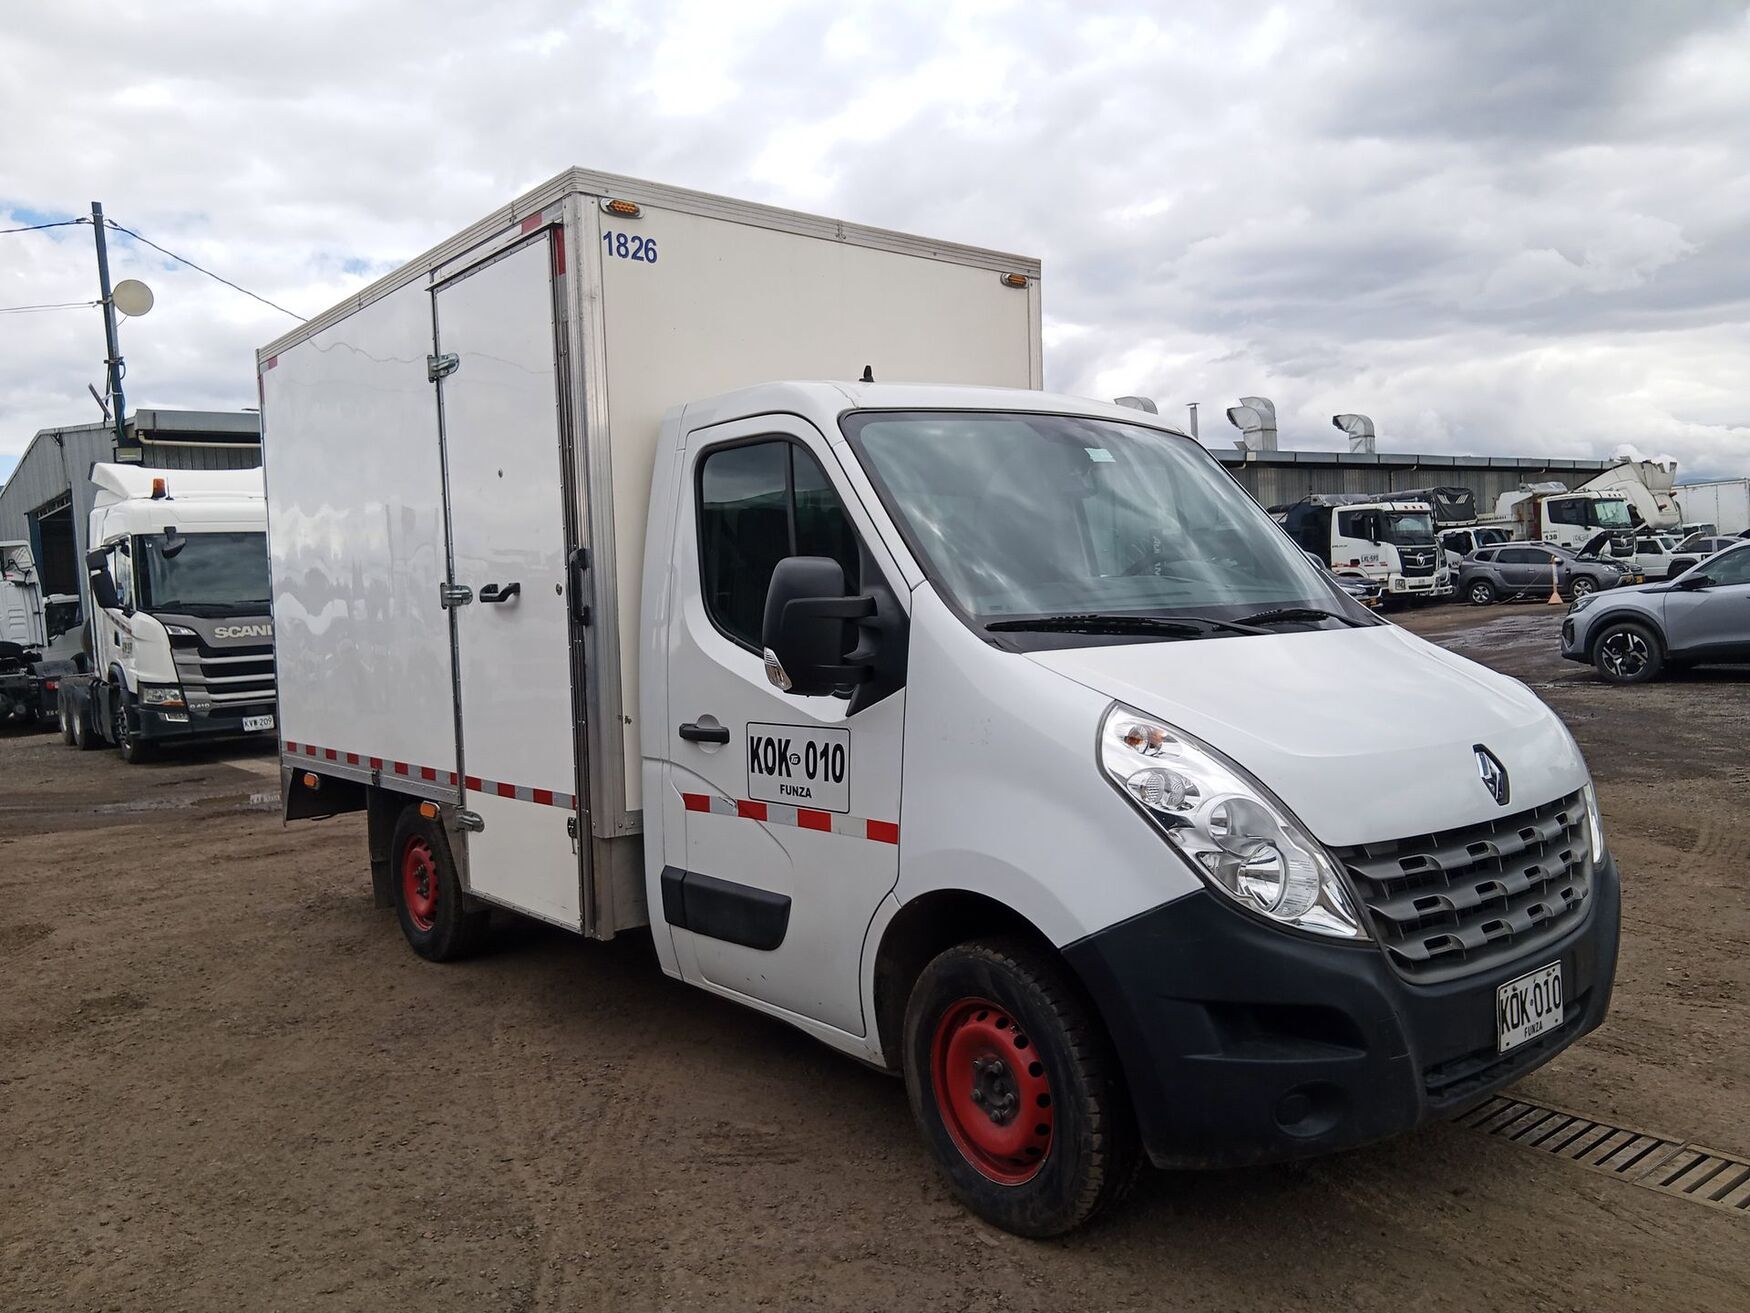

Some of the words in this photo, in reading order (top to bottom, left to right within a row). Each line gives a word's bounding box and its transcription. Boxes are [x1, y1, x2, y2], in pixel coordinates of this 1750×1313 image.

[603, 231, 657, 263] 1826
[214, 624, 273, 638] SCANI
[750, 736, 792, 777] KOK
[805, 740, 845, 783] 010
[780, 784, 812, 798] FUNZA
[1500, 987, 1531, 1036] KOK
[1533, 974, 1561, 1018] 010
[1524, 1021, 1543, 1038] FUNZA
